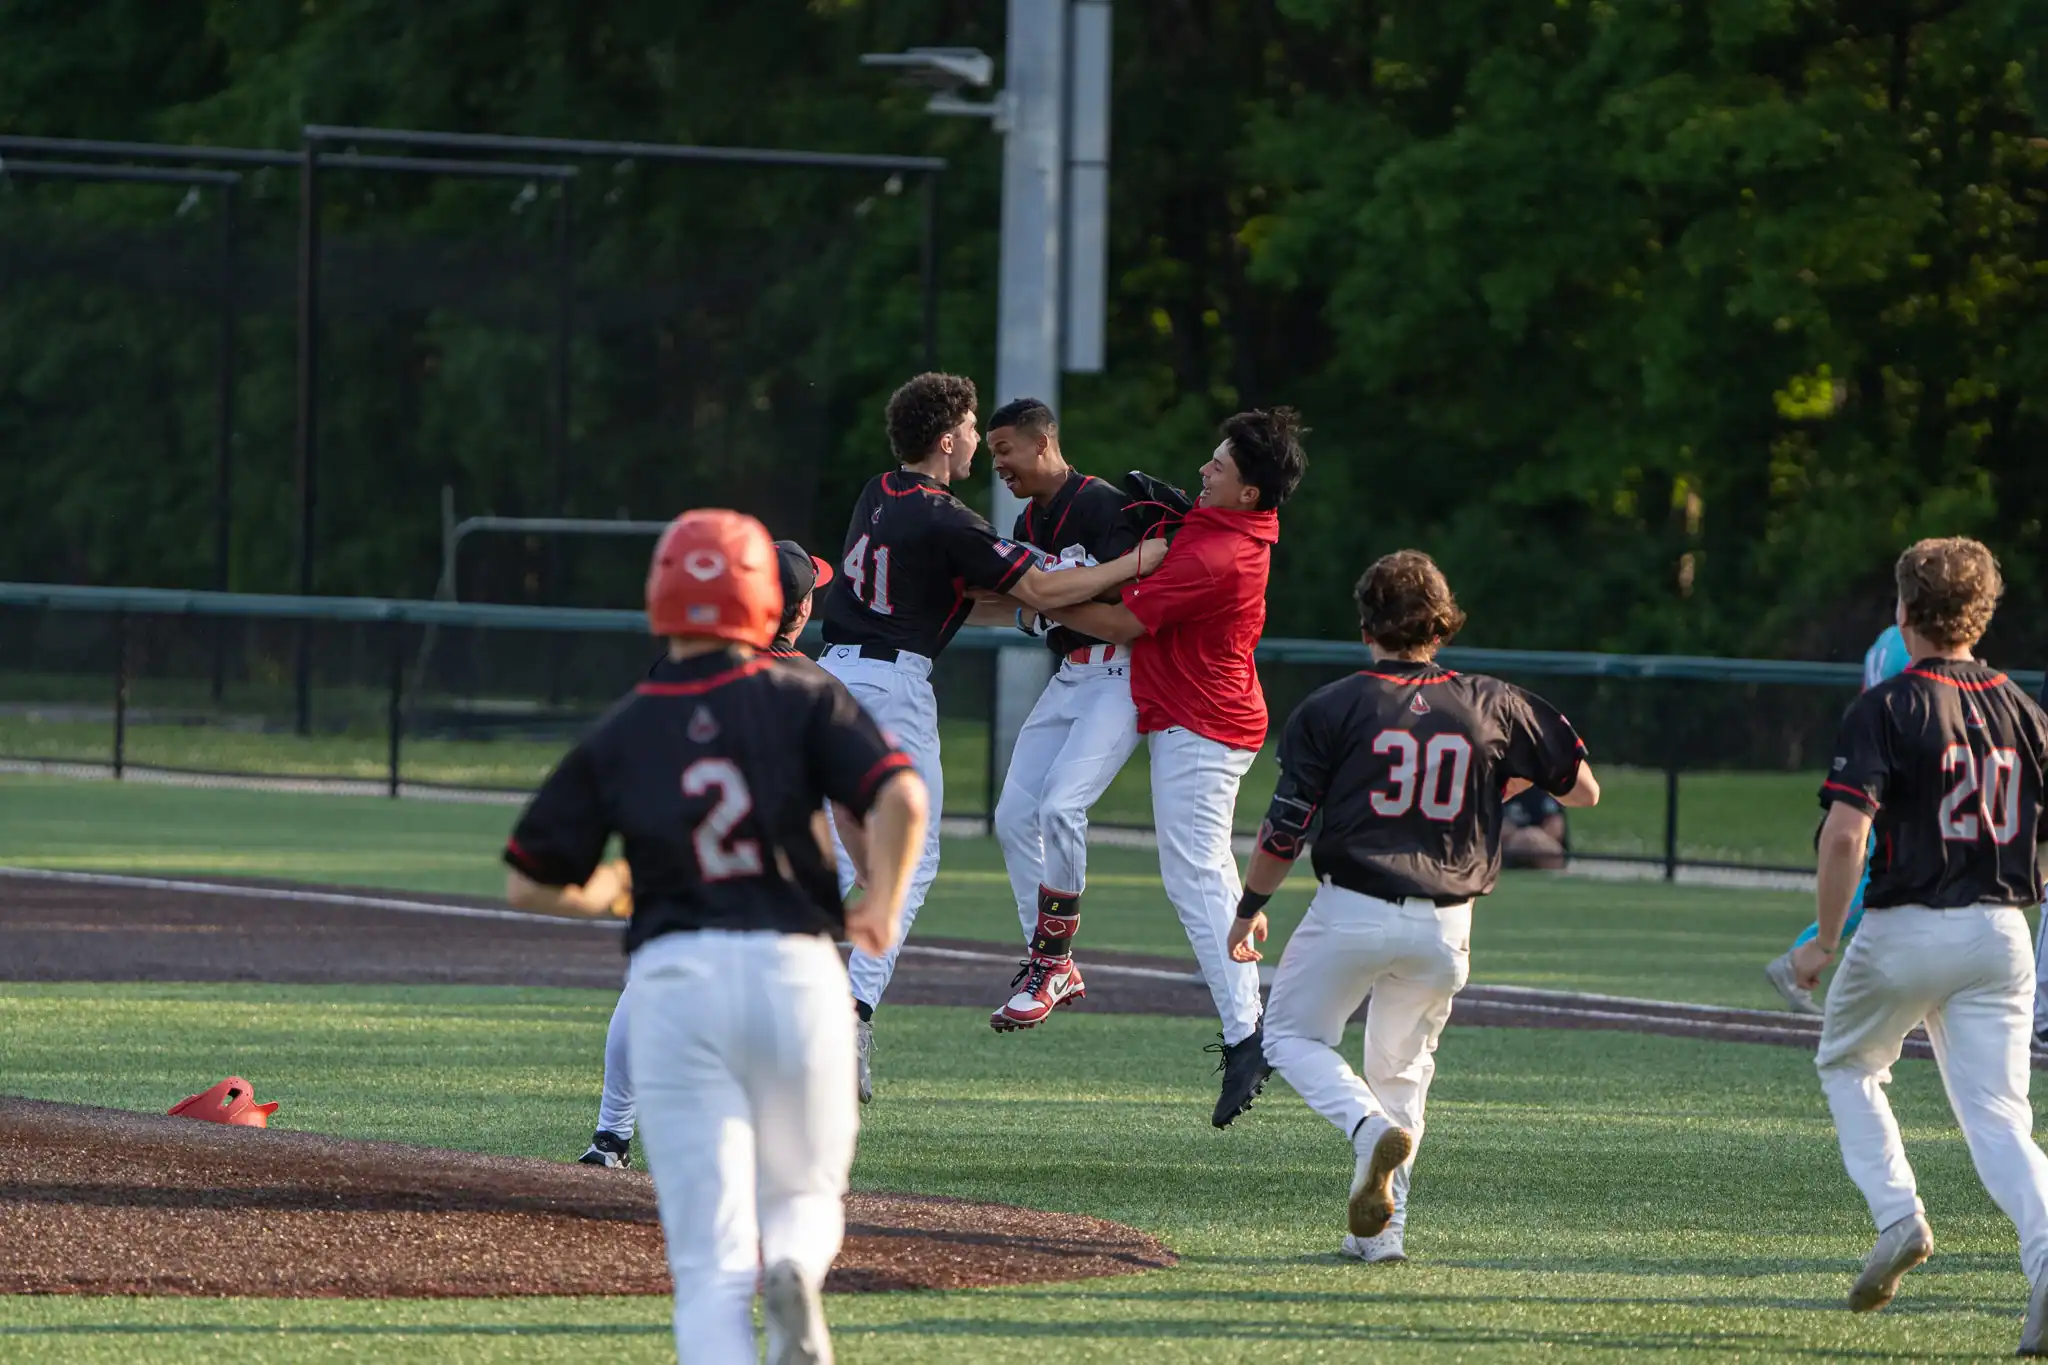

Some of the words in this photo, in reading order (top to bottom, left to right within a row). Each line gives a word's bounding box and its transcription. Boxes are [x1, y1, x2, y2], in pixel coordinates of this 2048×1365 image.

[843, 532, 895, 616] 41
[681, 757, 764, 882] 2
[1370, 728, 1473, 822] 30
[1938, 741, 2023, 845] 20
